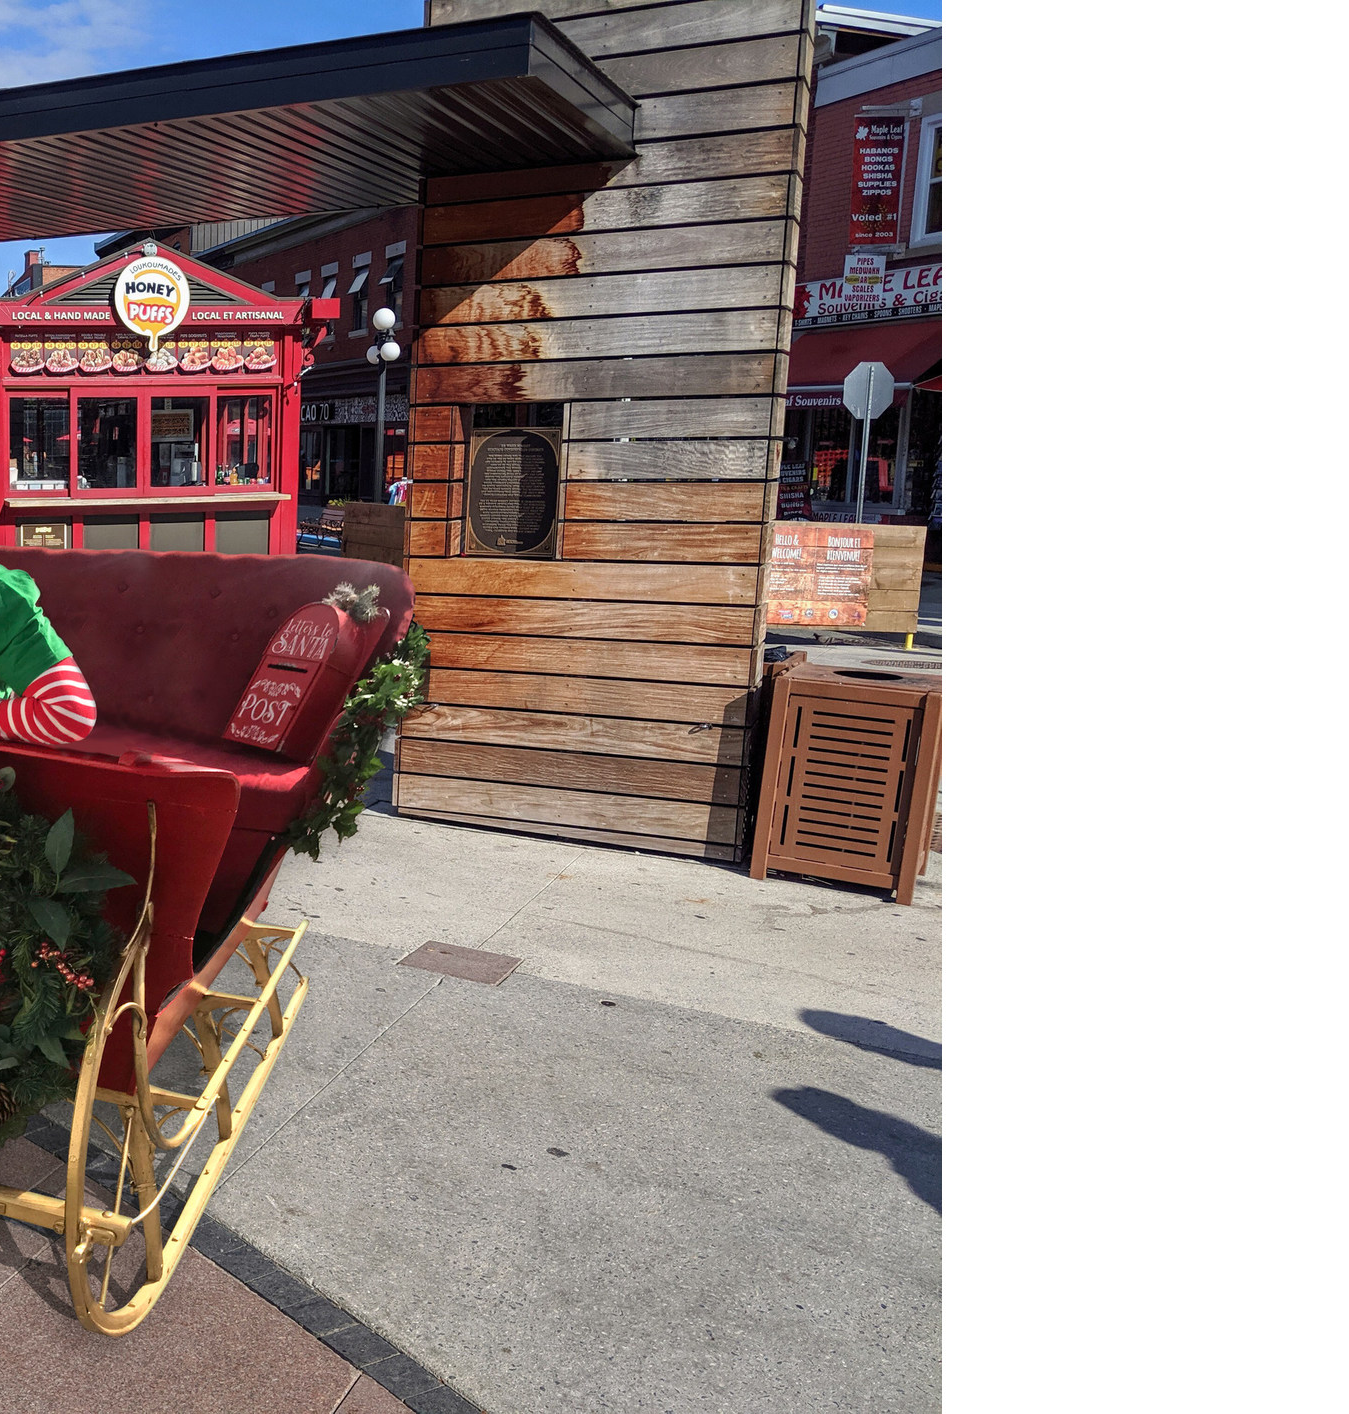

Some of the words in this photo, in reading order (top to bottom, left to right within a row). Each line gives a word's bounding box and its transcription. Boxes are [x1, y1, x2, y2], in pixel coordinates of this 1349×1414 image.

[870, 125, 889, 135] Maple
[890, 125, 903, 133] Leaf
[864, 155, 894, 163] BONGS
[851, 213, 882, 221] Voted
[886, 212, 898, 221] #1
[856, 257, 875, 266] PIPES
[129, 261, 183, 282] LOUKOUMADES
[124, 281, 176, 298] HONEY
[852, 285, 875, 293] SCALES
[844, 294, 881, 302] VAPORIZERS
[893, 293, 908, 307] &
[12, 311, 43, 320] LOCAL
[44, 311, 52, 320] &
[53, 311, 81, 320] HAND
[83, 311, 111, 320] MADE
[127, 301, 175, 326] PUFFS
[191, 311, 222, 320] LOCAL
[223, 311, 234, 320] ET
[235, 311, 284, 320] ARTISANAL
[873, 309, 893, 319] SPOONS
[898, 305, 923, 316] SHOOTERS
[794, 395, 842, 407] Souvenirs
[301, 404, 317, 421] CAO
[319, 403, 330, 420] 70
[780, 492, 805, 500] SHISHA
[775, 533, 792, 546] HELLO
[792, 534, 799, 546] &
[827, 536, 854, 549] BONJOUR
[854, 537, 861, 548] ET
[771, 547, 802, 560] WELCOME!
[284, 618, 320, 639] Letters
[320, 621, 334, 638] to
[271, 631, 330, 660] SANTA
[237, 693, 292, 726] POST
